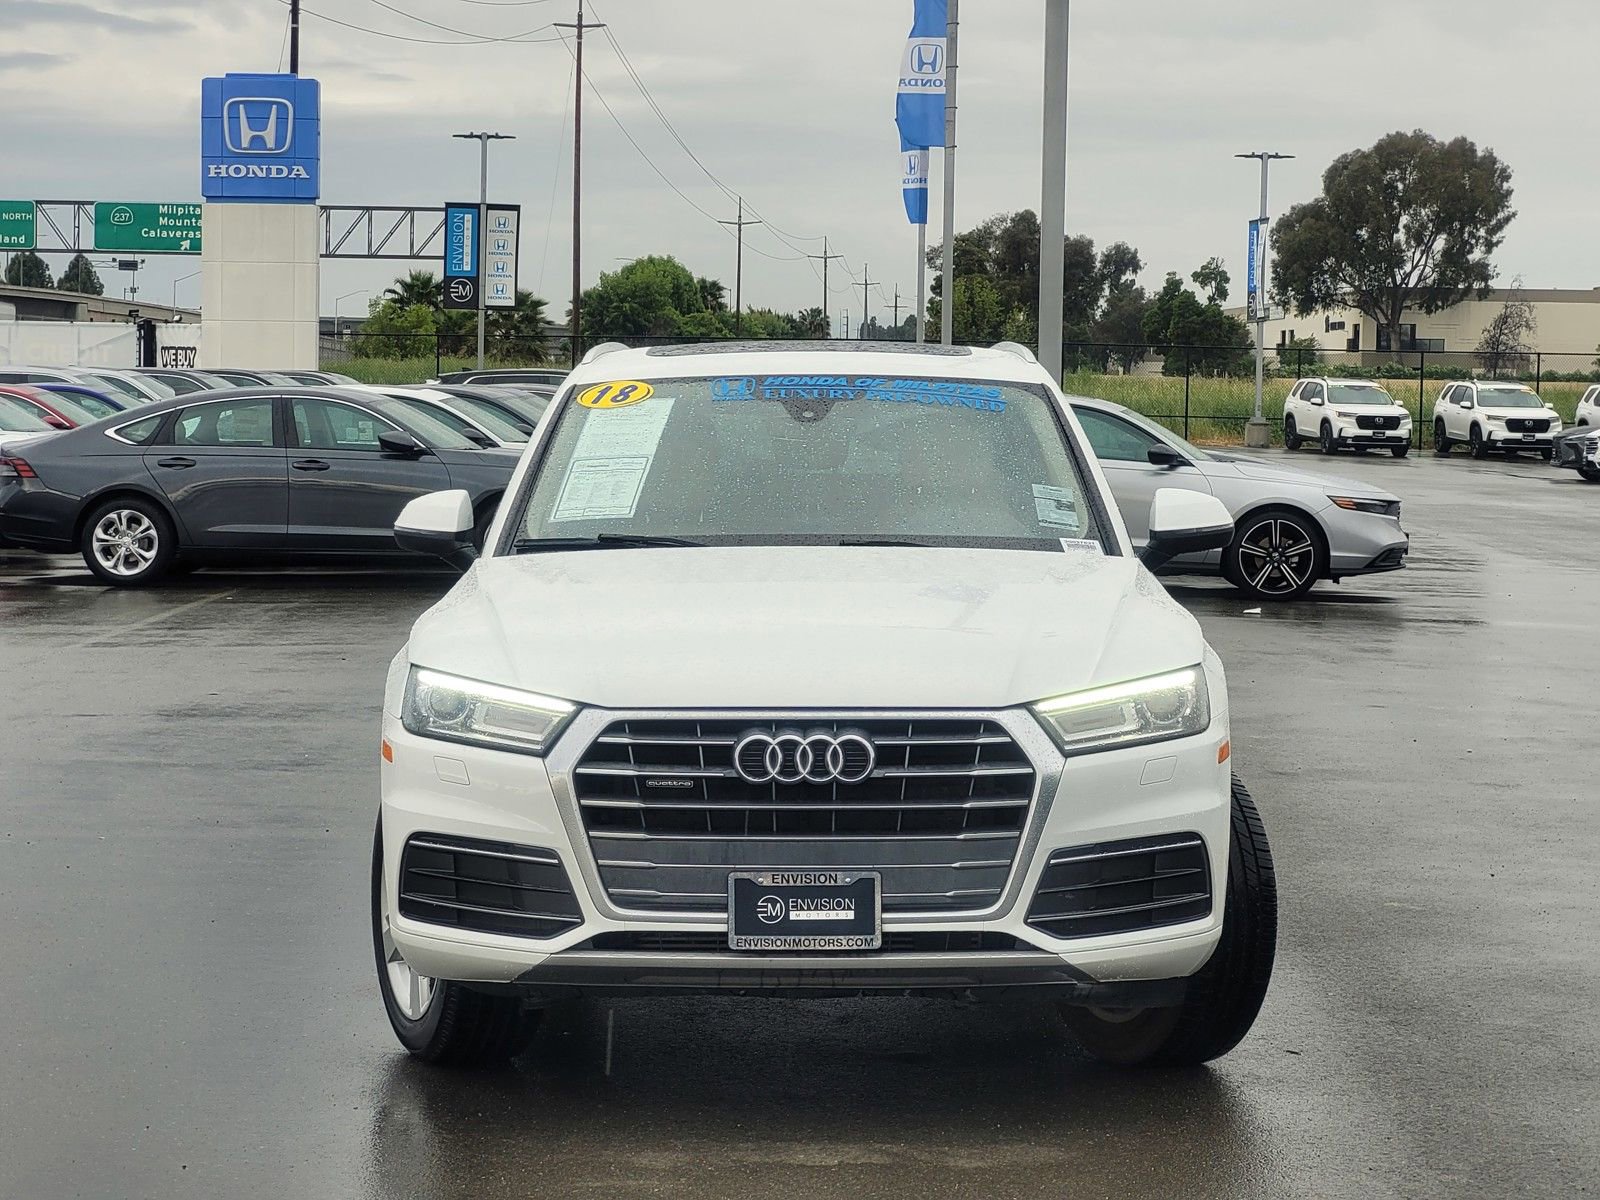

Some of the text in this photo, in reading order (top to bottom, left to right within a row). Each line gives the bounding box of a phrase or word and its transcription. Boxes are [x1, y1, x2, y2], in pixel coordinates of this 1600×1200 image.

[207, 164, 310, 179] HONDA
[114, 213, 130, 221] 237
[141, 228, 202, 238] Calaveras
[452, 213, 464, 272] ENVISION
[161, 347, 196, 367] WE BUY
[763, 377, 1002, 397] HONDA OF MILPITAS
[591, 385, 638, 404] 18
[764, 389, 857, 399] LUXURY
[771, 873, 838, 884] ENVISION
[789, 898, 855, 910] ENVISION
[736, 938, 874, 948] ENVISIONMOTORS.COM
